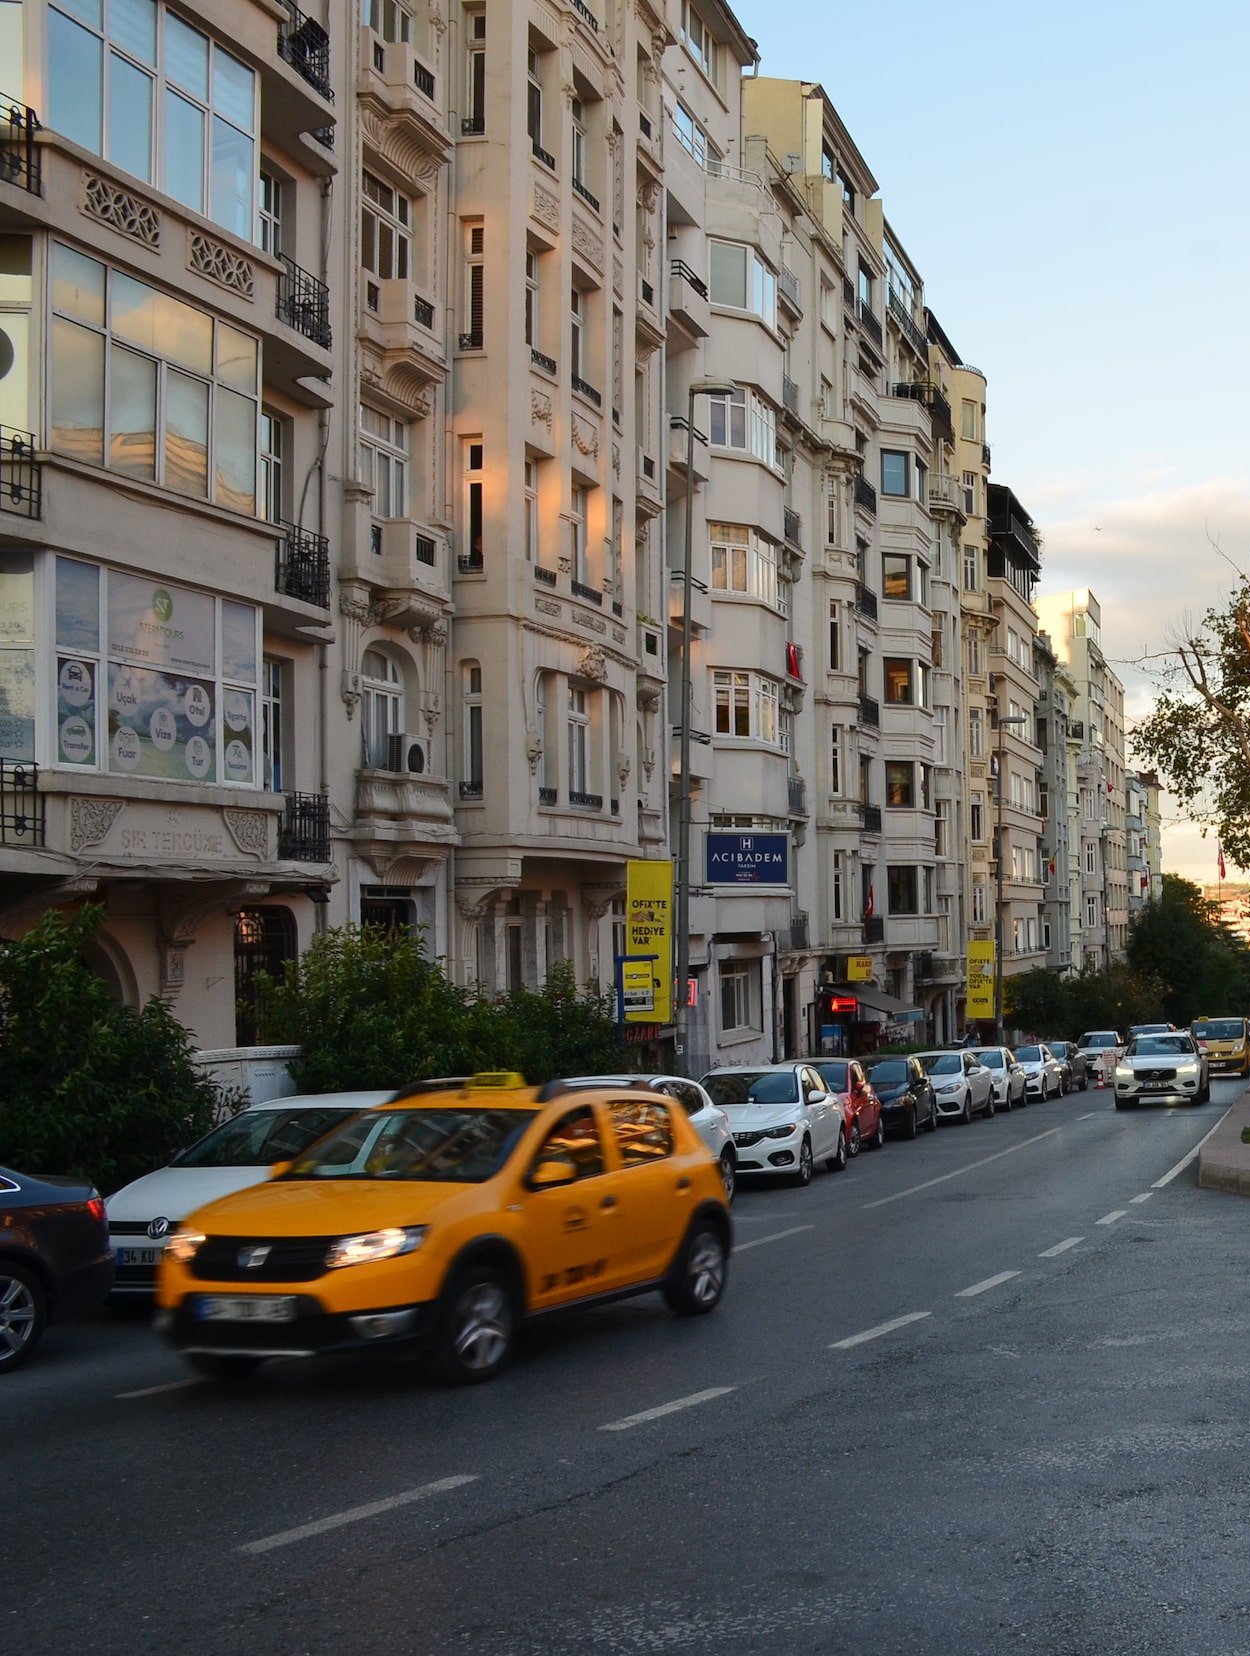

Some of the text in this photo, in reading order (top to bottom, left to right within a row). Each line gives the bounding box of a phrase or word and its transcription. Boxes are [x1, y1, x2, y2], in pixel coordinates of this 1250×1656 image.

[116, 692, 137, 706] Uçak
[189, 705, 205, 716] Otel
[155, 728, 171, 740] Vize
[64, 740, 89, 750] Transfer
[118, 747, 136, 759] Fuar
[192, 756, 204, 766] Tur
[712, 853, 782, 863] ACIBADEM
[124, 1250, 137, 1264] 34
[141, 1251, 155, 1264] KU
